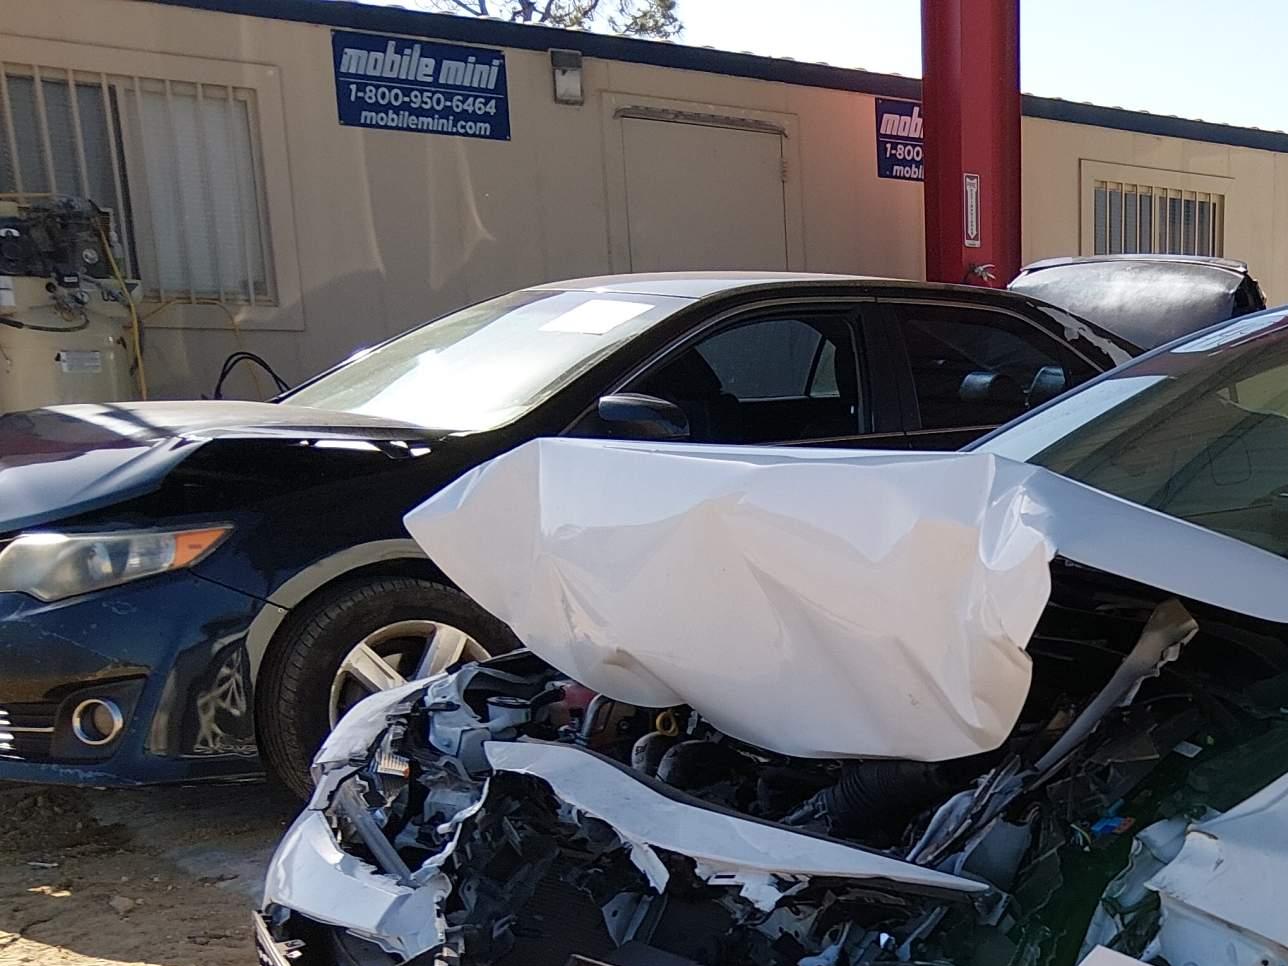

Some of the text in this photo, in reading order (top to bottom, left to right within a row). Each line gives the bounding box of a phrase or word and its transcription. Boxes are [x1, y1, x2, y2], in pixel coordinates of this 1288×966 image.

[339, 40, 500, 89] mobile mini
[349, 84, 497, 116] 1-800-950-6464
[360, 109, 491, 136] mobilemini.com
